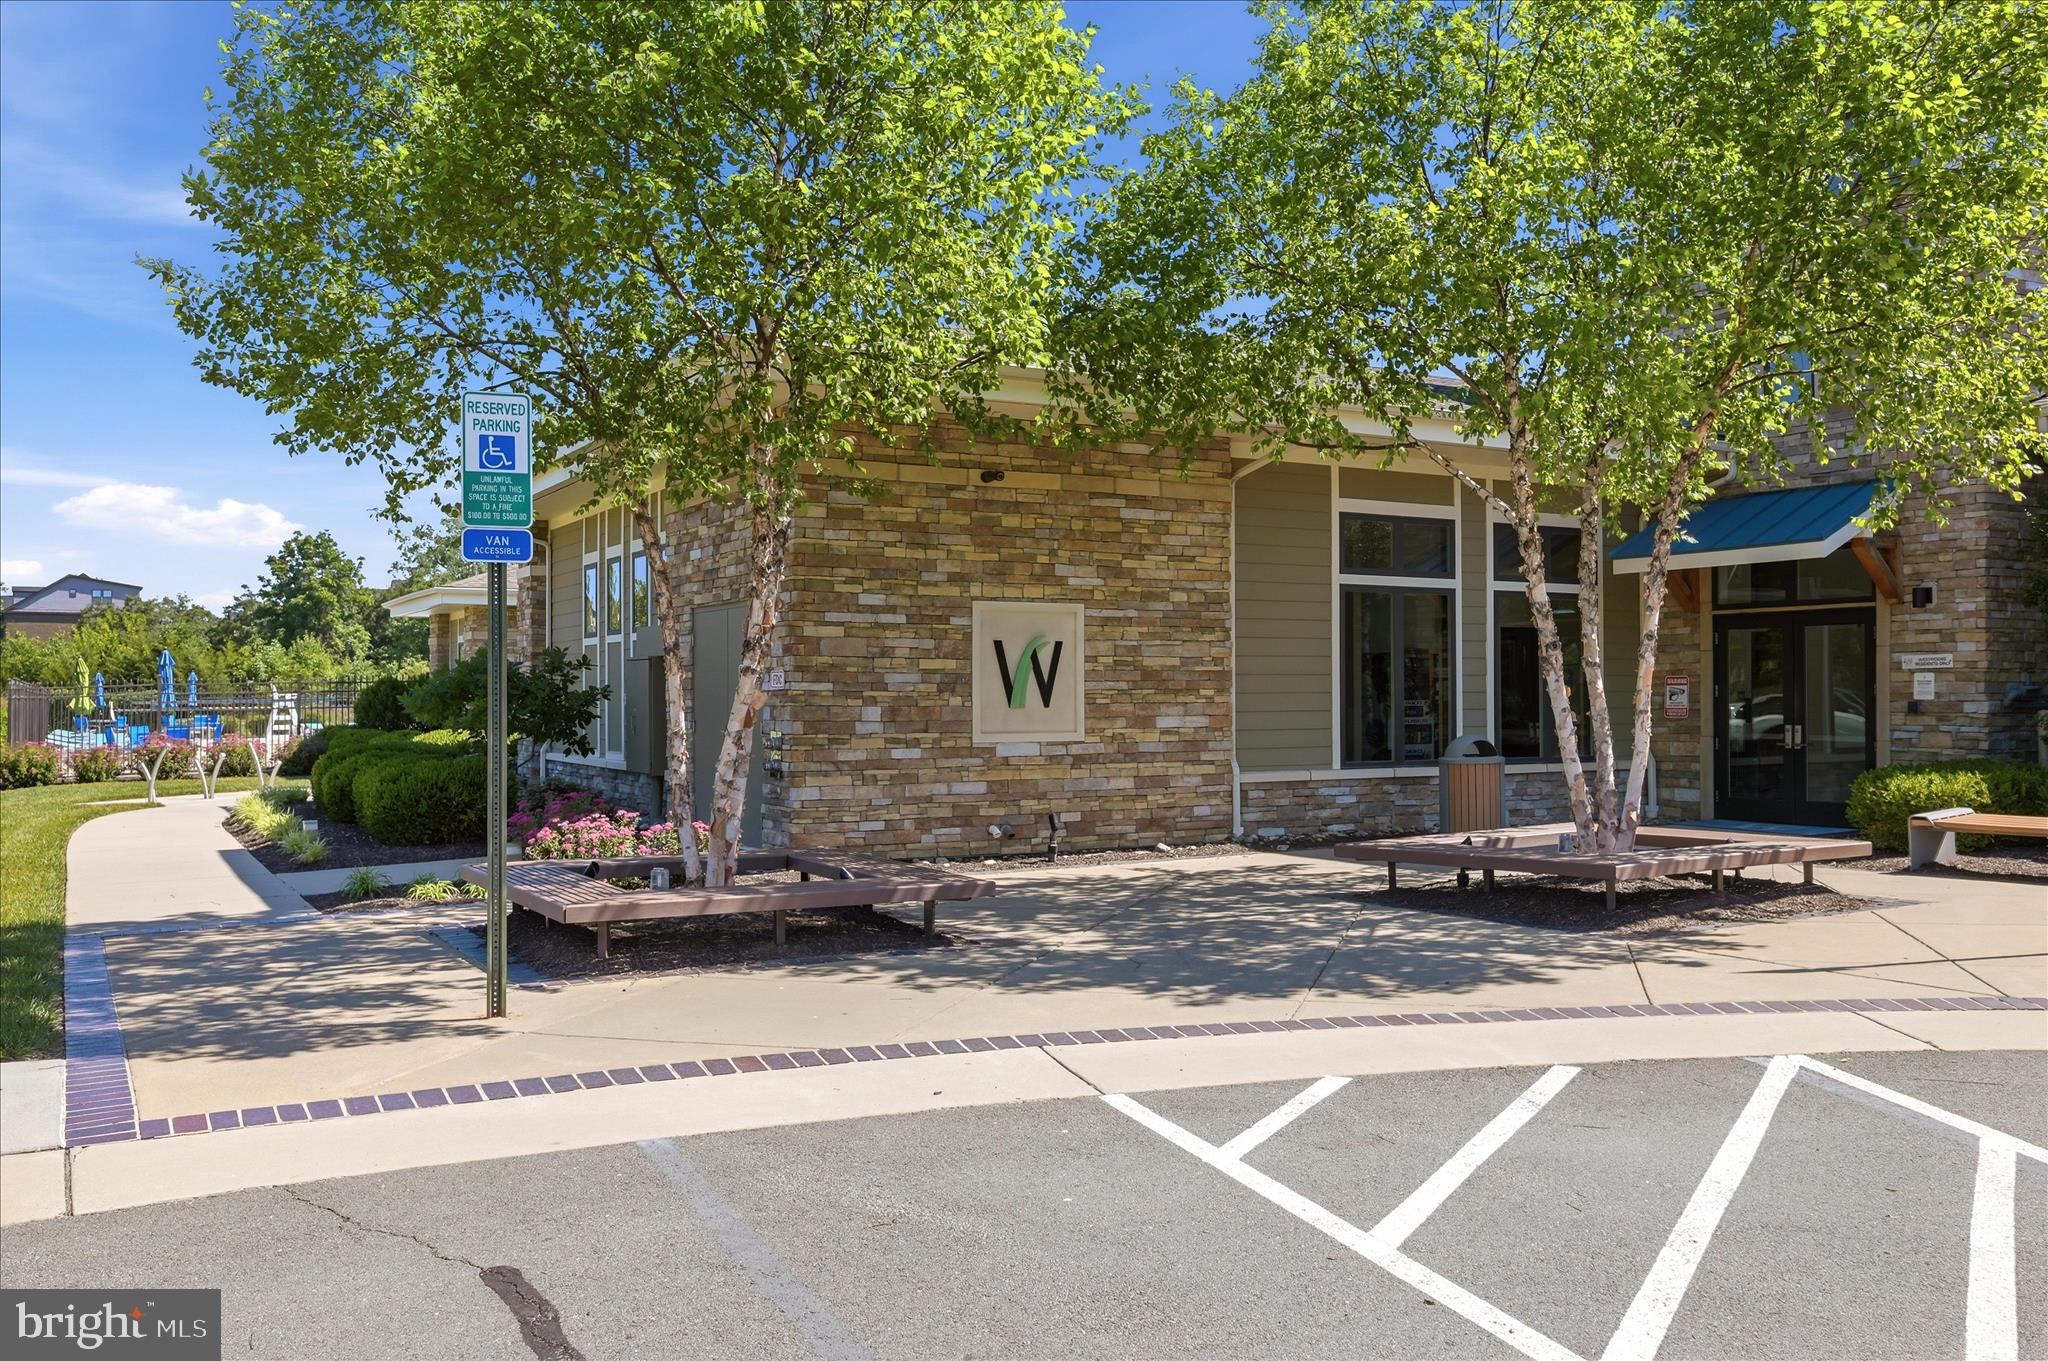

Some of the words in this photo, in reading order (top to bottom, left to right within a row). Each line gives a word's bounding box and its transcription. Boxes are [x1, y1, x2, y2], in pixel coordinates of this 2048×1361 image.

[467, 400, 526, 416] RESERVED
[472, 418, 521, 433] PARKING
[480, 475, 513, 484] UNLAWFUL
[472, 484, 498, 492] PARKING
[509, 485, 522, 494] THIS
[498, 494, 526, 502] SUBJECT
[498, 503, 512, 511] FINE
[486, 536, 510, 546] VAN
[473, 547, 521, 555] ACCESSIBLE
